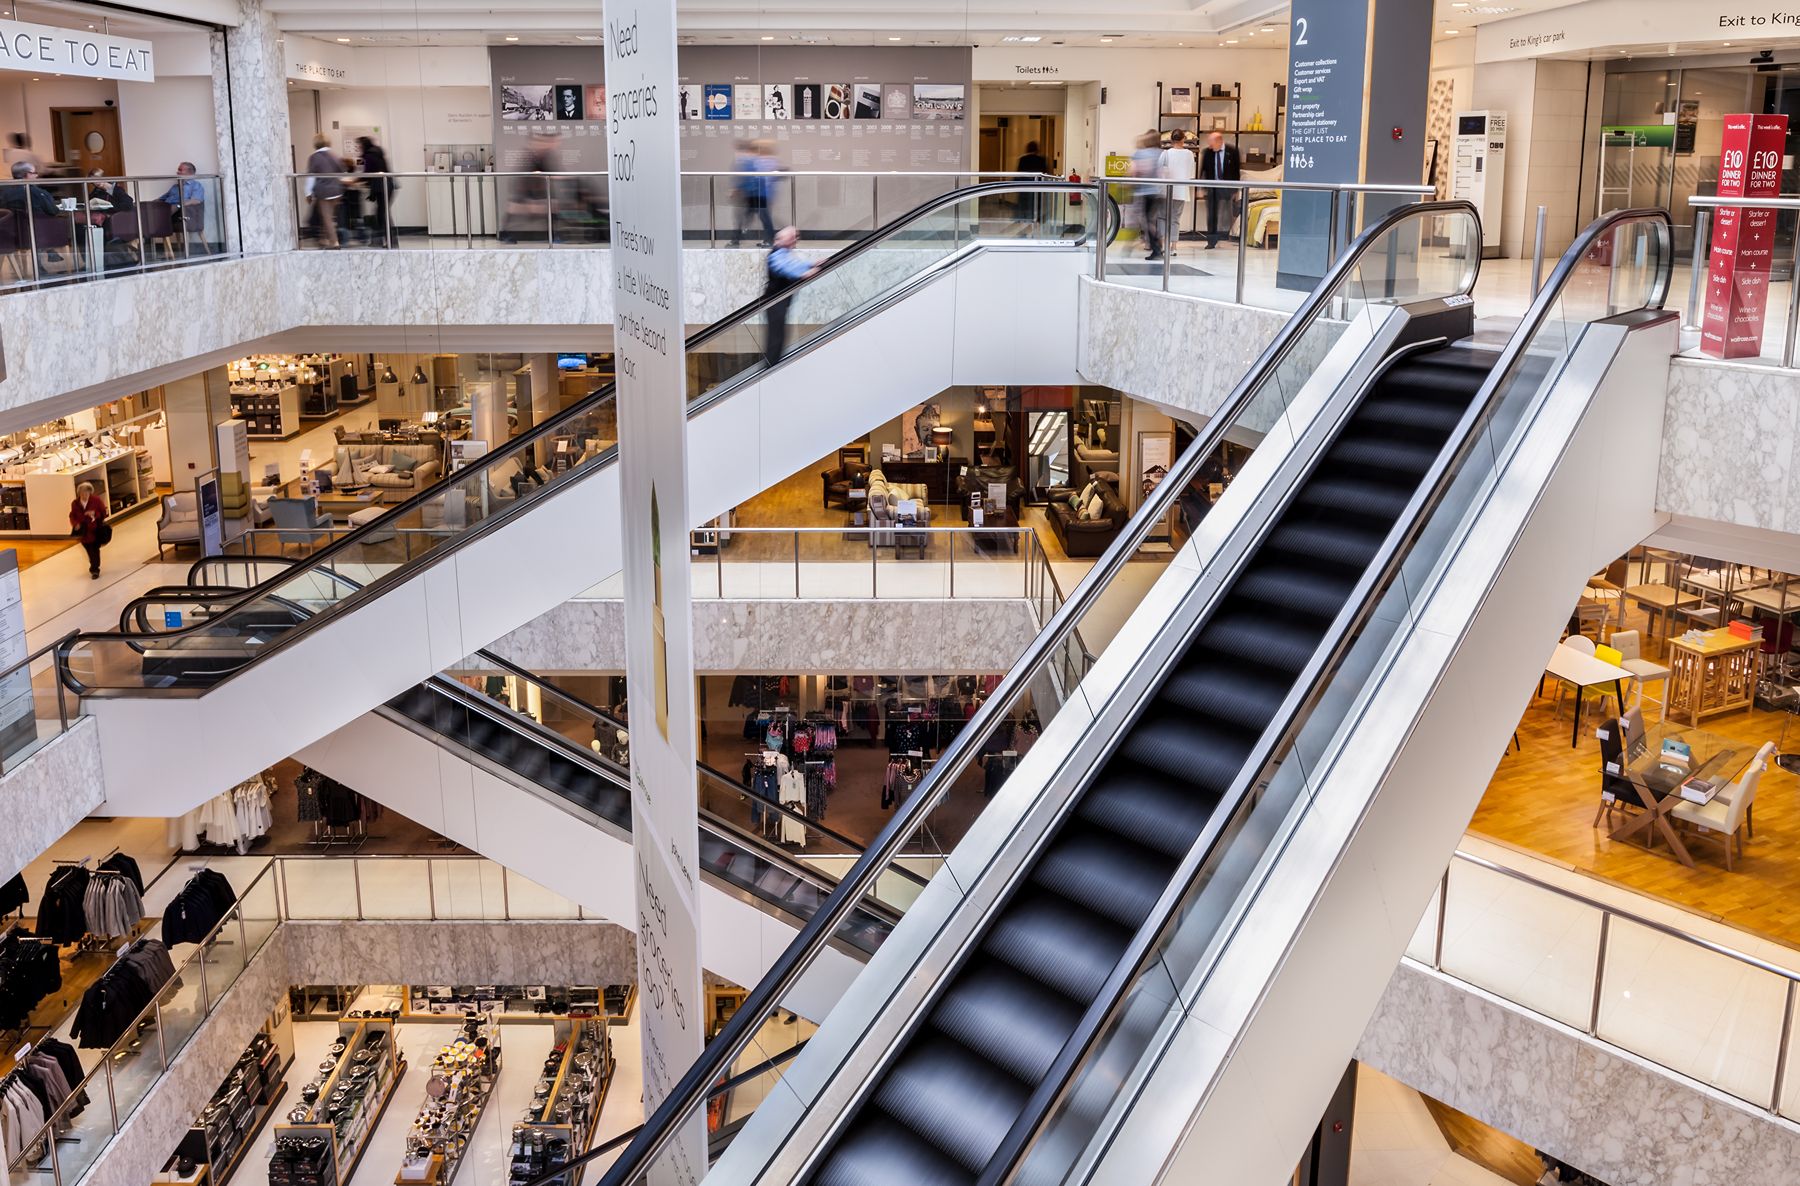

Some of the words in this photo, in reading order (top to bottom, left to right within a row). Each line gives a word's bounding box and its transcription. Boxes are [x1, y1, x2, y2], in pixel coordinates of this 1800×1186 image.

[1719, 15, 1746, 27] Exit
[1750, 15, 1766, 26] to
[610, 8, 638, 61] Need
[1296, 17, 1308, 46] 2
[1510, 38, 1520, 48] Exit
[1527, 34, 1542, 47] King's
[1543, 34, 1552, 43] car
[1552, 29, 1565, 44] park
[64, 40, 99, 66] TO
[108, 46, 150, 71] EAT
[1294, 60, 1315, 68] Customer
[296, 63, 307, 73] THE
[327, 68, 335, 78] TO
[336, 69, 345, 78] EAT
[1015, 65, 1041, 74] Toilets
[1294, 77, 1308, 85] Export
[612, 73, 658, 135] groceries
[1292, 111, 1315, 119] Partnership
[1490, 119, 1506, 127] FREE
[614, 139, 636, 182] too?
[1723, 149, 1743, 168] £10
[1753, 150, 1779, 169] £10
[1722, 170, 1742, 180] DINNER
[1751, 170, 1776, 180] DINNER
[1721, 179, 1731, 187] FOR
[1730, 180, 1741, 188] TWO
[1750, 180, 1761, 188] FOR
[1762, 180, 1776, 188] TWO
[1719, 208, 1731, 216] Starter
[1748, 210, 1764, 218] Starter
[1750, 219, 1767, 227] dessert
[616, 221, 639, 252] There's
[640, 234, 655, 257] now
[1741, 248, 1753, 256] Main
[1712, 274, 1720, 283] Side
[1741, 277, 1752, 285] Side
[1751, 276, 1761, 285] dish
[623, 266, 637, 295] little
[637, 270, 670, 310] Waitrose
[1734, 315, 1759, 323] chocolates
[628, 311, 640, 340] the
[641, 316, 667, 356] Second
[1730, 335, 1758, 343] waitrose.com
[639, 850, 667, 939] Need
[640, 911, 686, 1030] groceries
[642, 951, 664, 1021] too?
